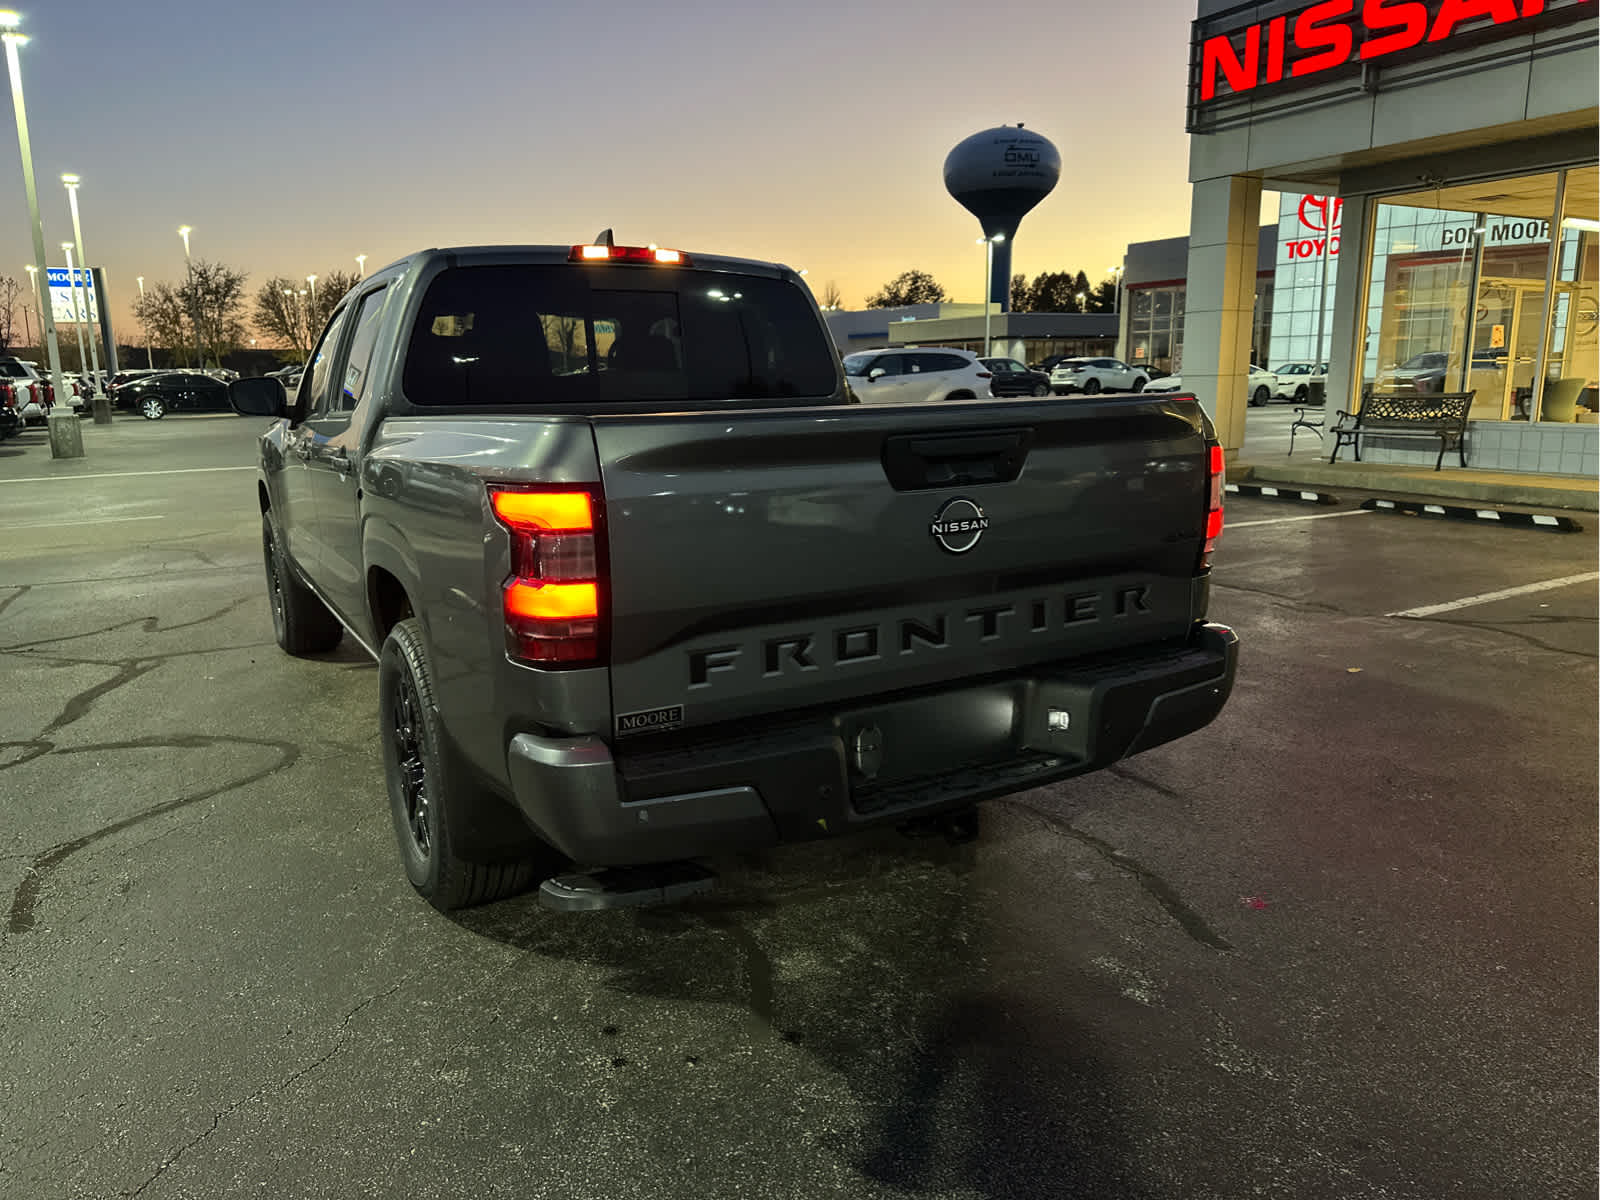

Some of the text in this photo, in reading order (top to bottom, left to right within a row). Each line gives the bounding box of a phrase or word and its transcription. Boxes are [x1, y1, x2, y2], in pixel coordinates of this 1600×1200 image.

[1201, 0, 1592, 100] NISSA
[931, 519, 989, 534] NISSAN
[687, 585, 1152, 689] FRONTIER
[623, 709, 679, 729] MOORE
